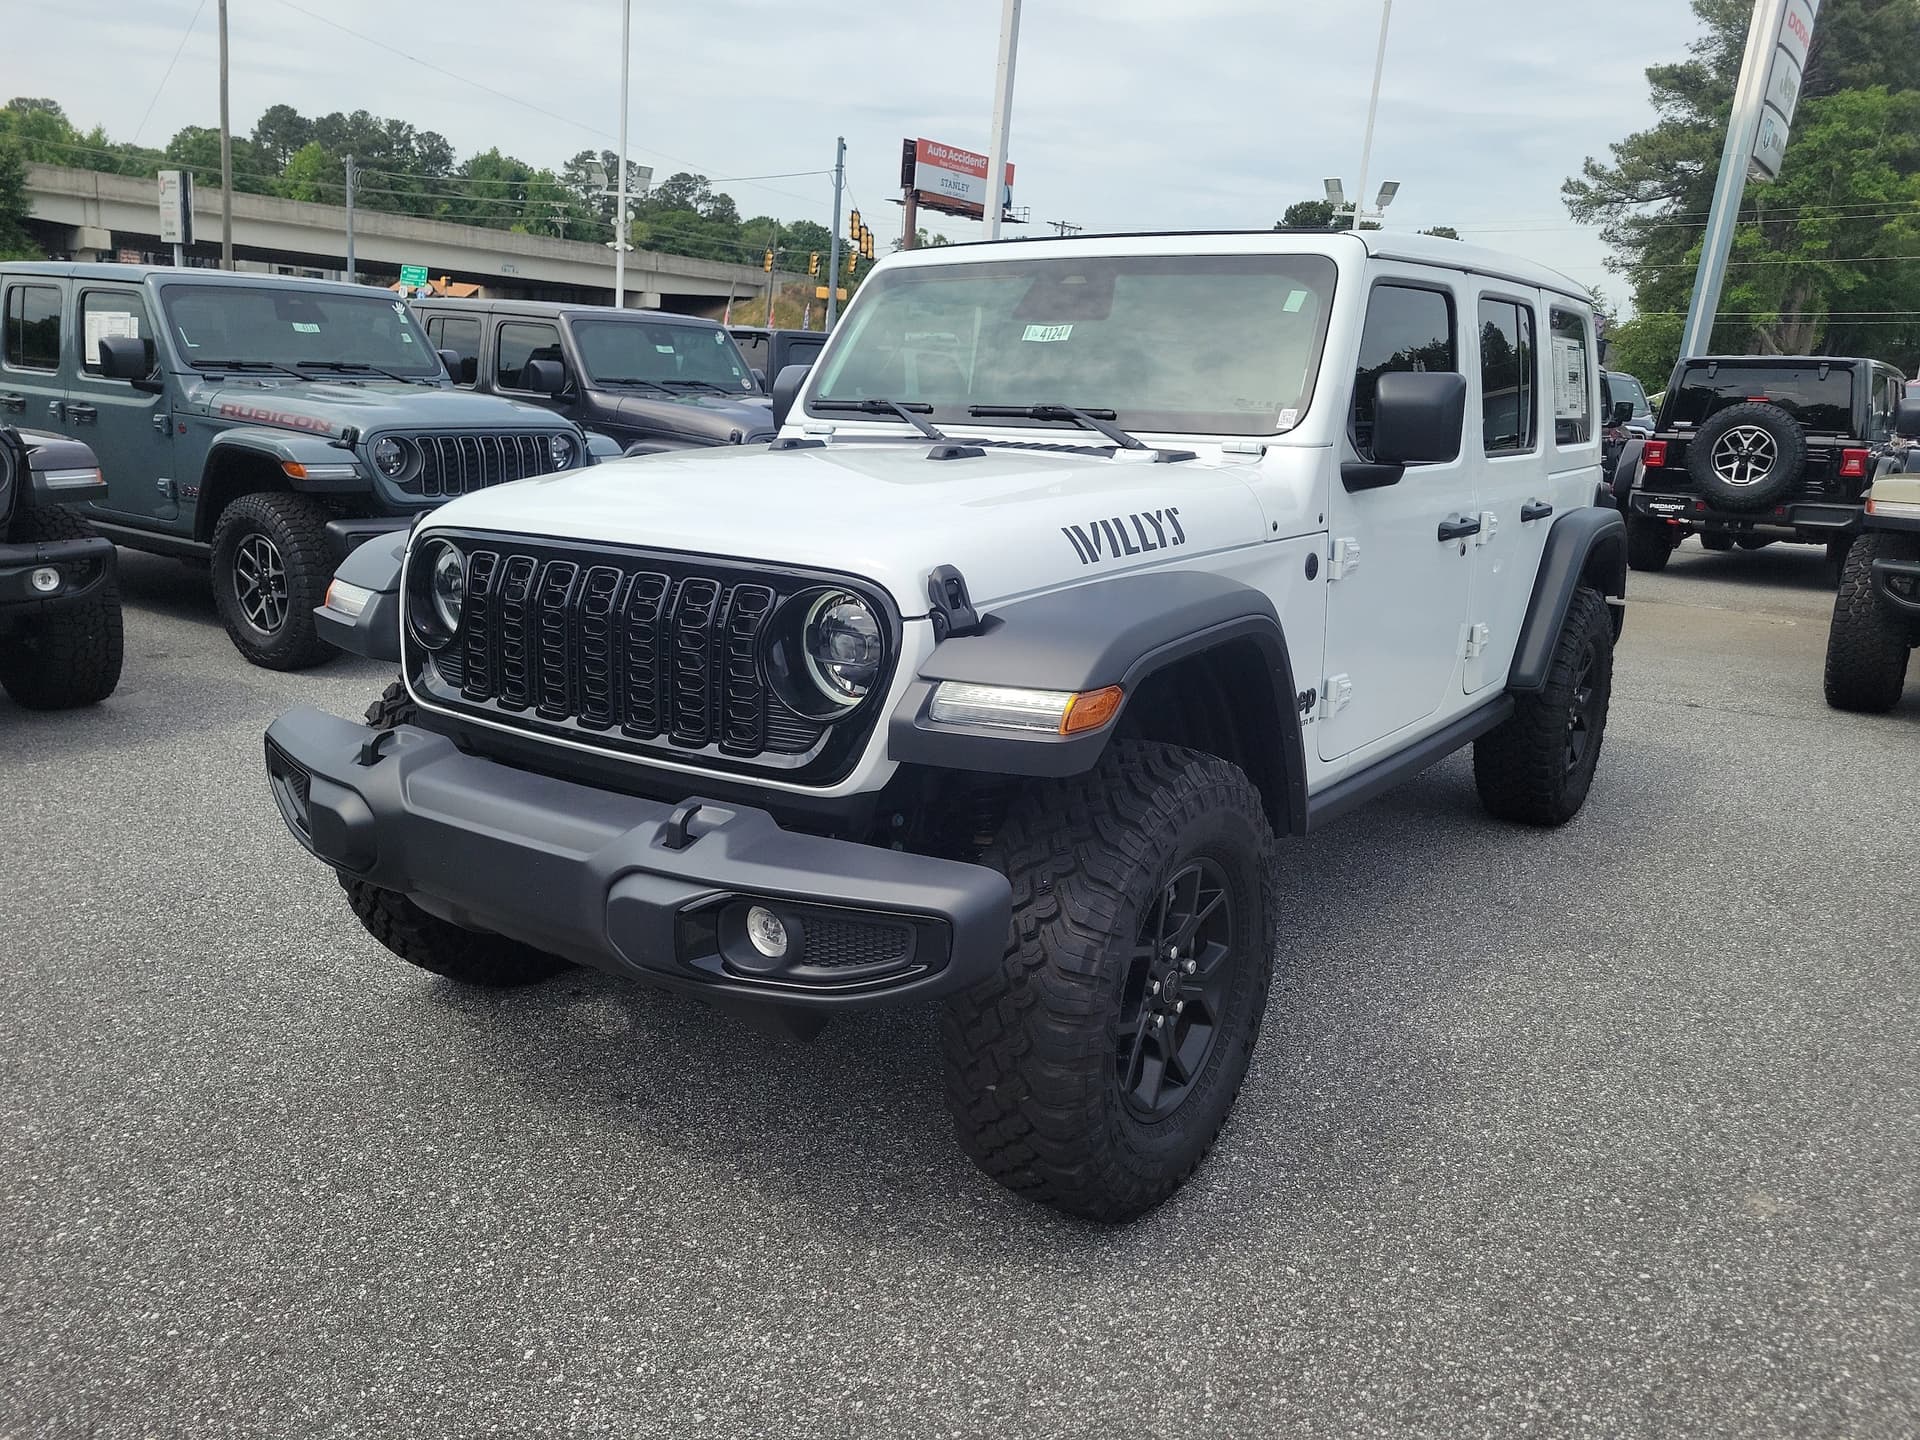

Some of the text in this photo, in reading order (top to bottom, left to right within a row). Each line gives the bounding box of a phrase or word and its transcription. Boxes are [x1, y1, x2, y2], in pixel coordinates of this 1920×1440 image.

[1788, 11, 1809, 49] DODG
[927, 144, 987, 169] Auto Accident?
[940, 178, 970, 192] STANLEY
[1040, 327, 1064, 340] 4124
[220, 403, 332, 432] RUBICON
[1649, 503, 1685, 511] PIEDMONT
[1060, 507, 1186, 565] WILLYS
[1296, 687, 1317, 715] ep
